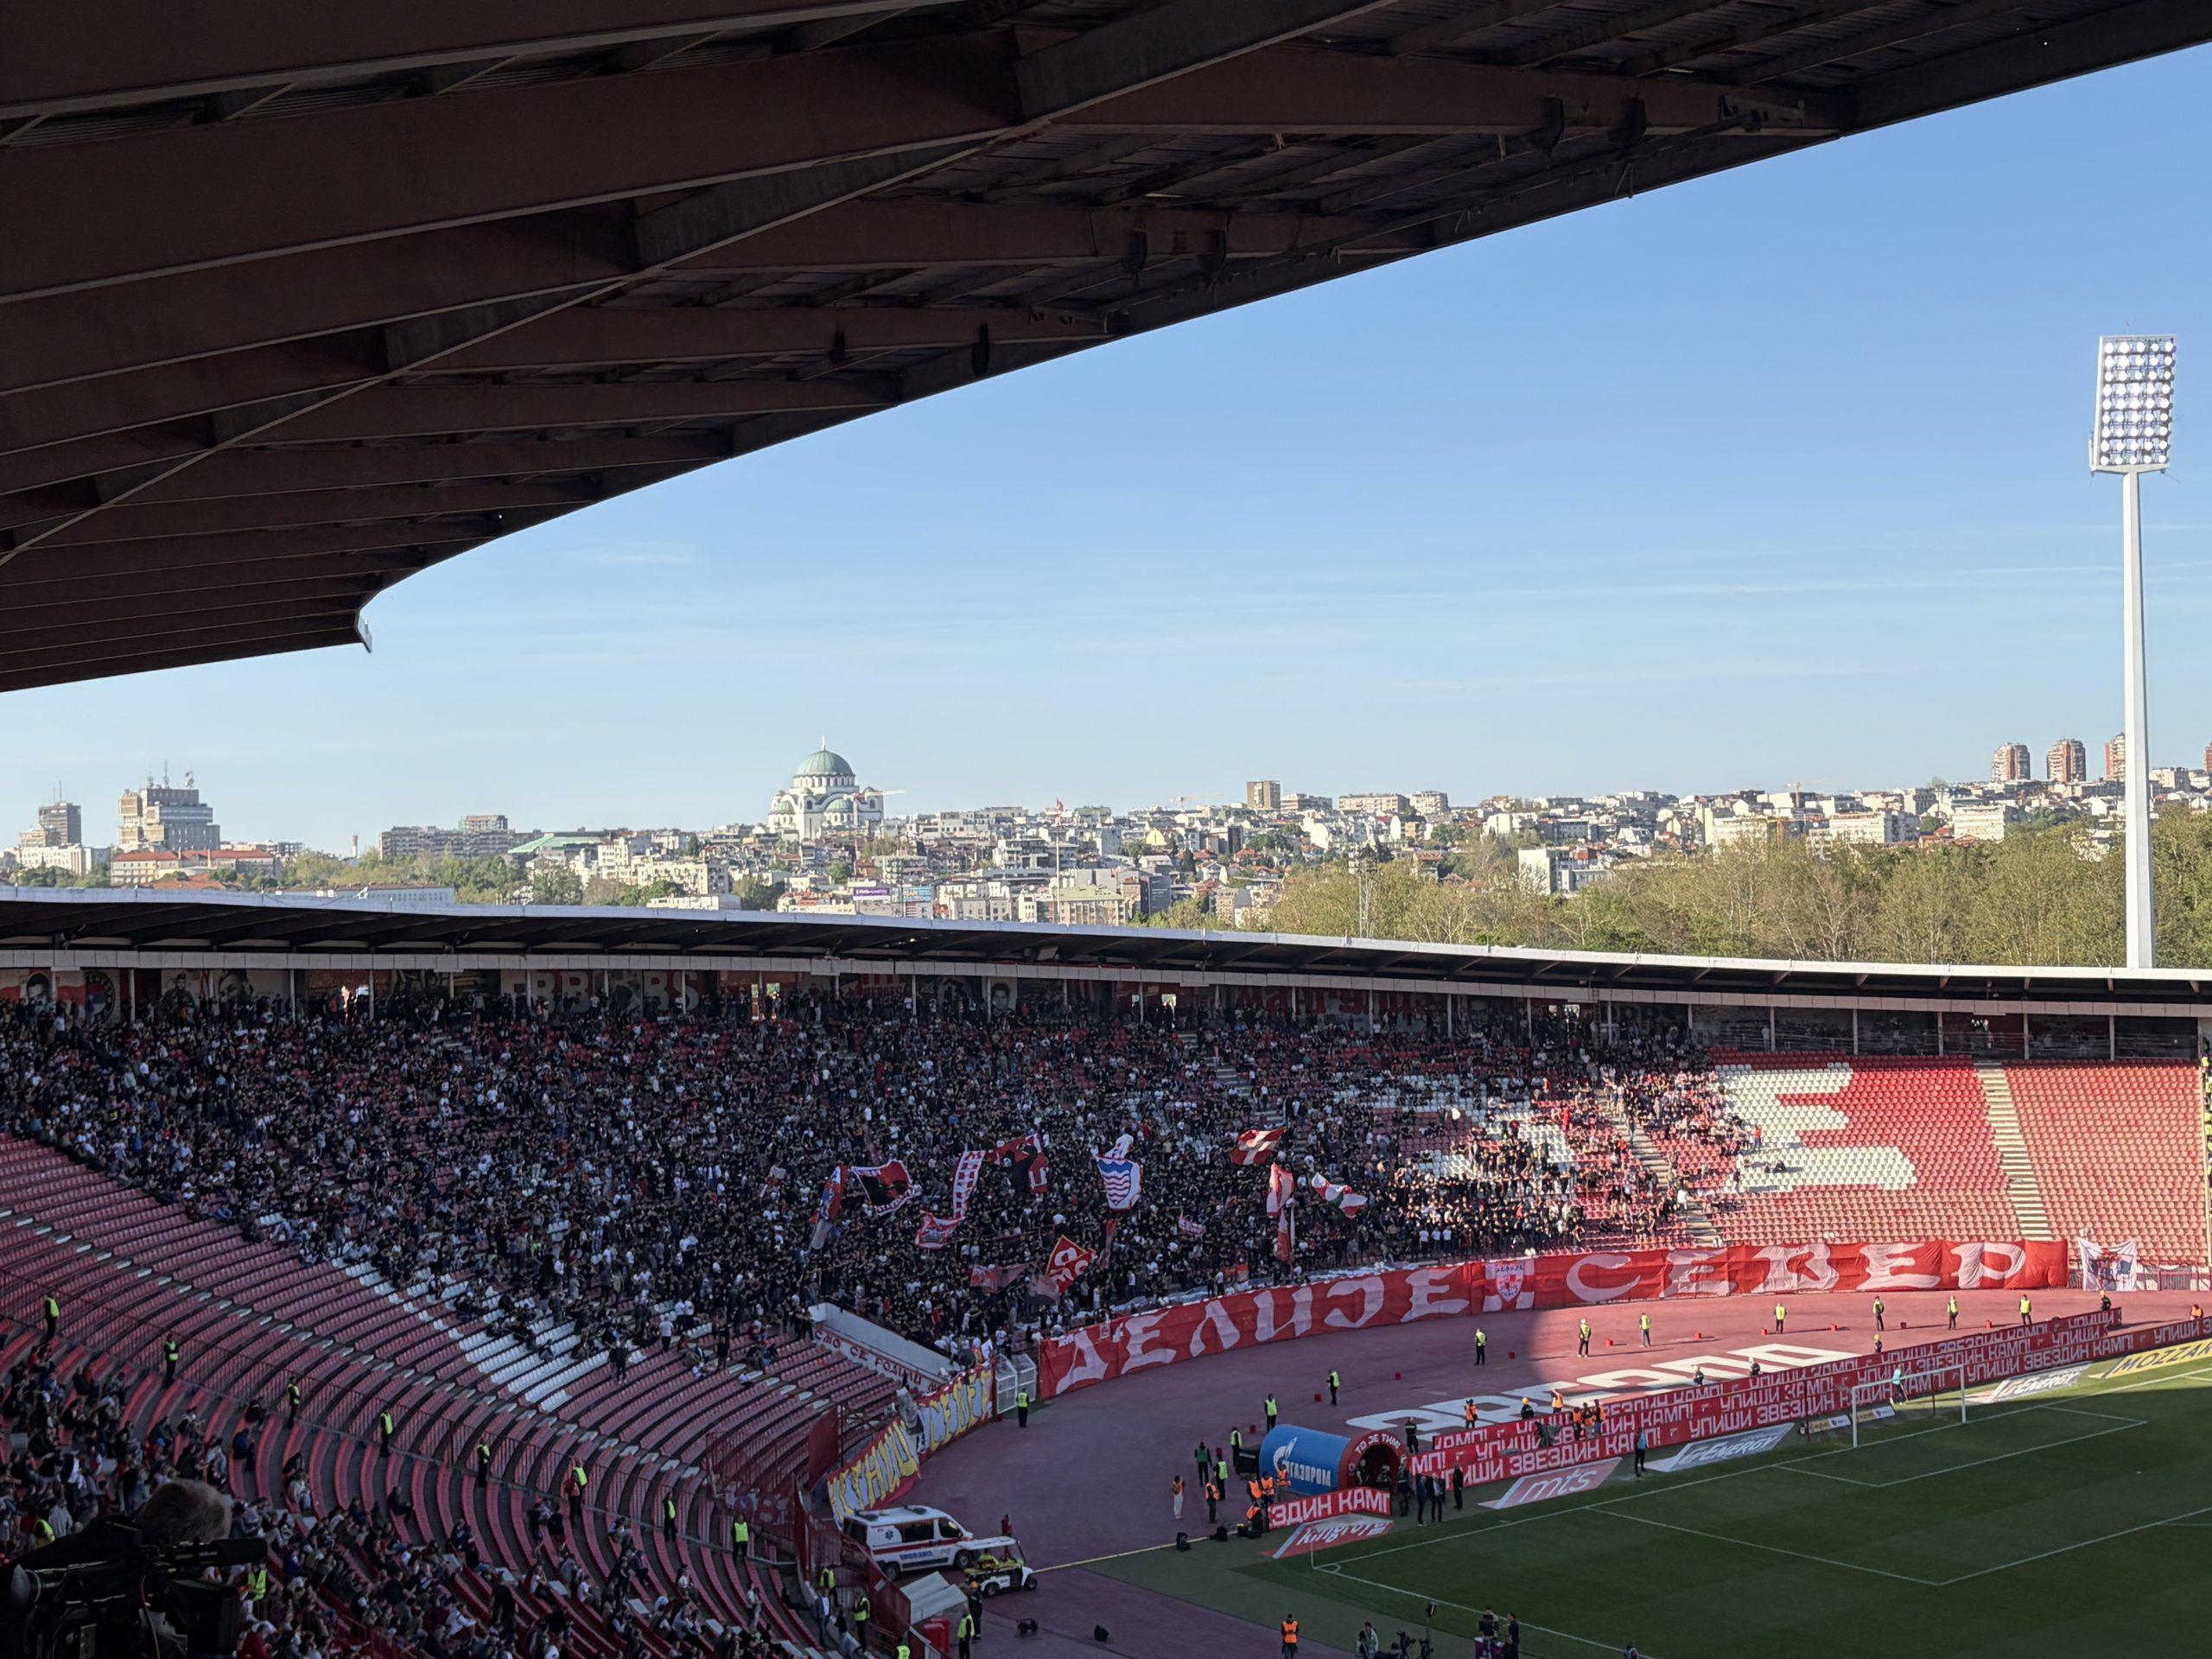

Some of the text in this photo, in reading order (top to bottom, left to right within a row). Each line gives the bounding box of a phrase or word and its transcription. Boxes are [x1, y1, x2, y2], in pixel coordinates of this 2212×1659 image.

[1056, 1243, 2026, 1395] ДЕЛИЈЕ СЕВЕР
[1510, 1441, 1600, 1475] ЗВЕЗДИН
[1689, 1408, 1751, 1438] УПИШИ
[1758, 1395, 1835, 1424] ЗВЕЗДИН
[1967, 1356, 2020, 1382] УПИШИ
[2024, 1344, 2088, 1370] ЗВЕЗДИН
[2094, 1333, 2134, 1357] КАМП!
[2153, 1322, 2200, 1344] УПИШИ
[1641, 1402, 1694, 1428] КАМП!
[1720, 1388, 1780, 1411] УПИШИ
[1989, 1339, 2031, 1360] КАМП!
[1290, 1461, 1331, 1486] ГАЗПРОМ
[1519, 1468, 1599, 1503] mts
